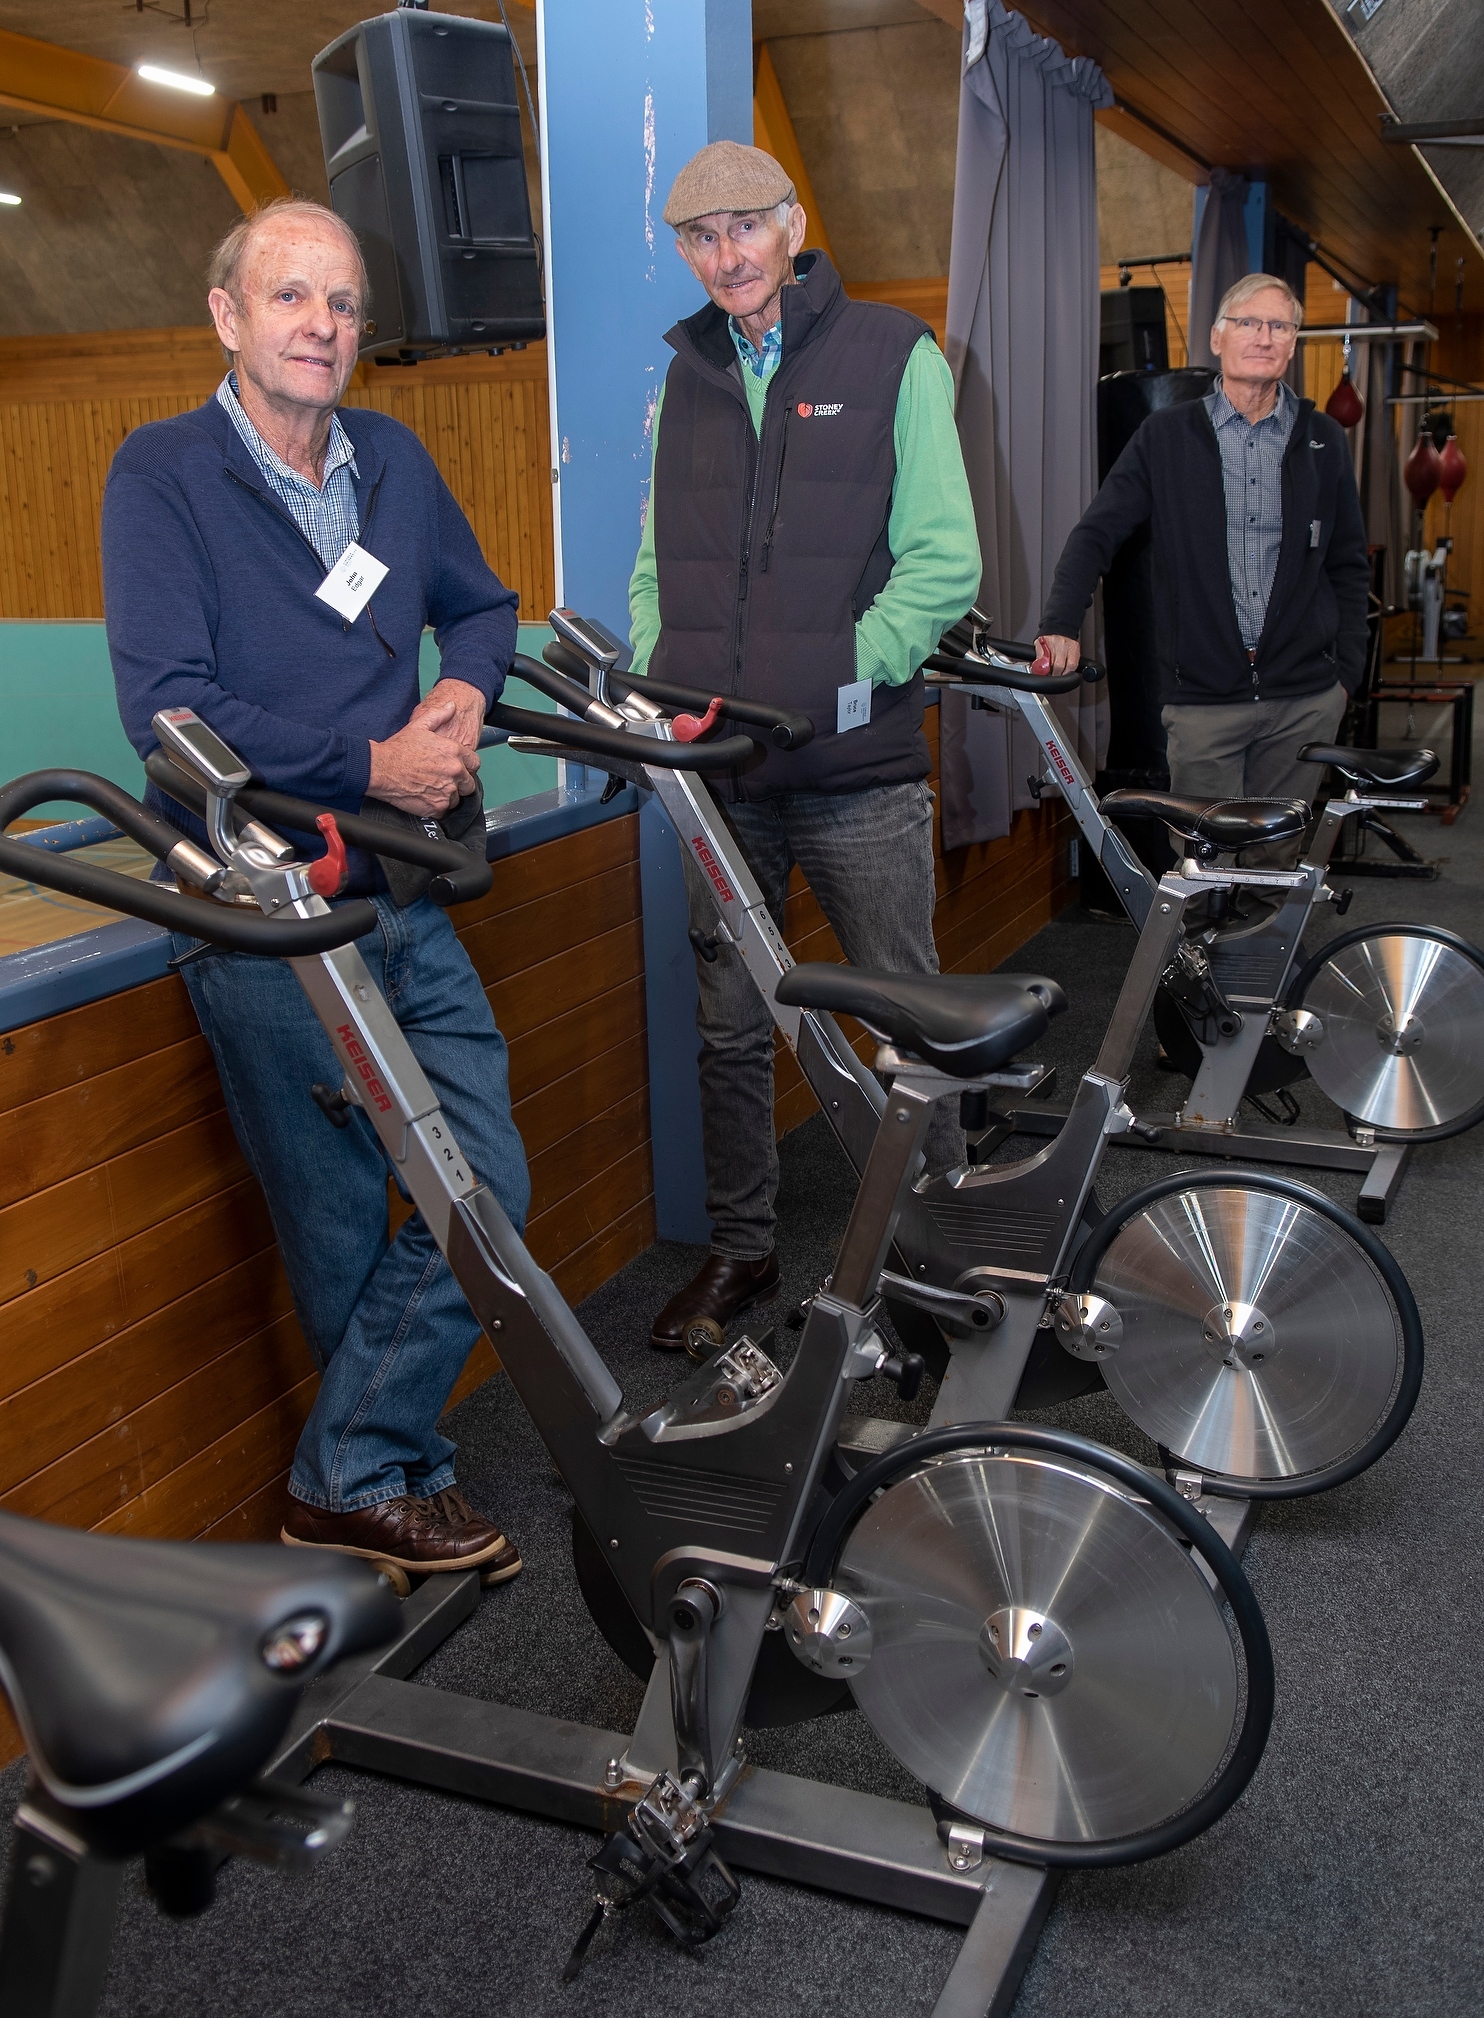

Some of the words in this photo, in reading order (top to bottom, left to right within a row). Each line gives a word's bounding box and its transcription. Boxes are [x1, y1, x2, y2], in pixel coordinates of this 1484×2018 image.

[814, 403, 844, 411] STONEY
[345, 571, 358, 587] John
[350, 575, 365, 592] Edgar
[168, 712, 194, 722] KEISER
[1045, 740, 1075, 785] KEISER
[691, 836, 735, 903] KEISER
[759, 910, 766, 920] 6
[768, 926, 775, 936] 5
[777, 942, 784, 952] 4
[784, 958, 792, 969] 3
[336, 1023, 393, 1113] KEISER
[431, 1126, 442, 1139] 3
[443, 1148, 454, 1161] 2
[455, 1169, 465, 1182] 1
